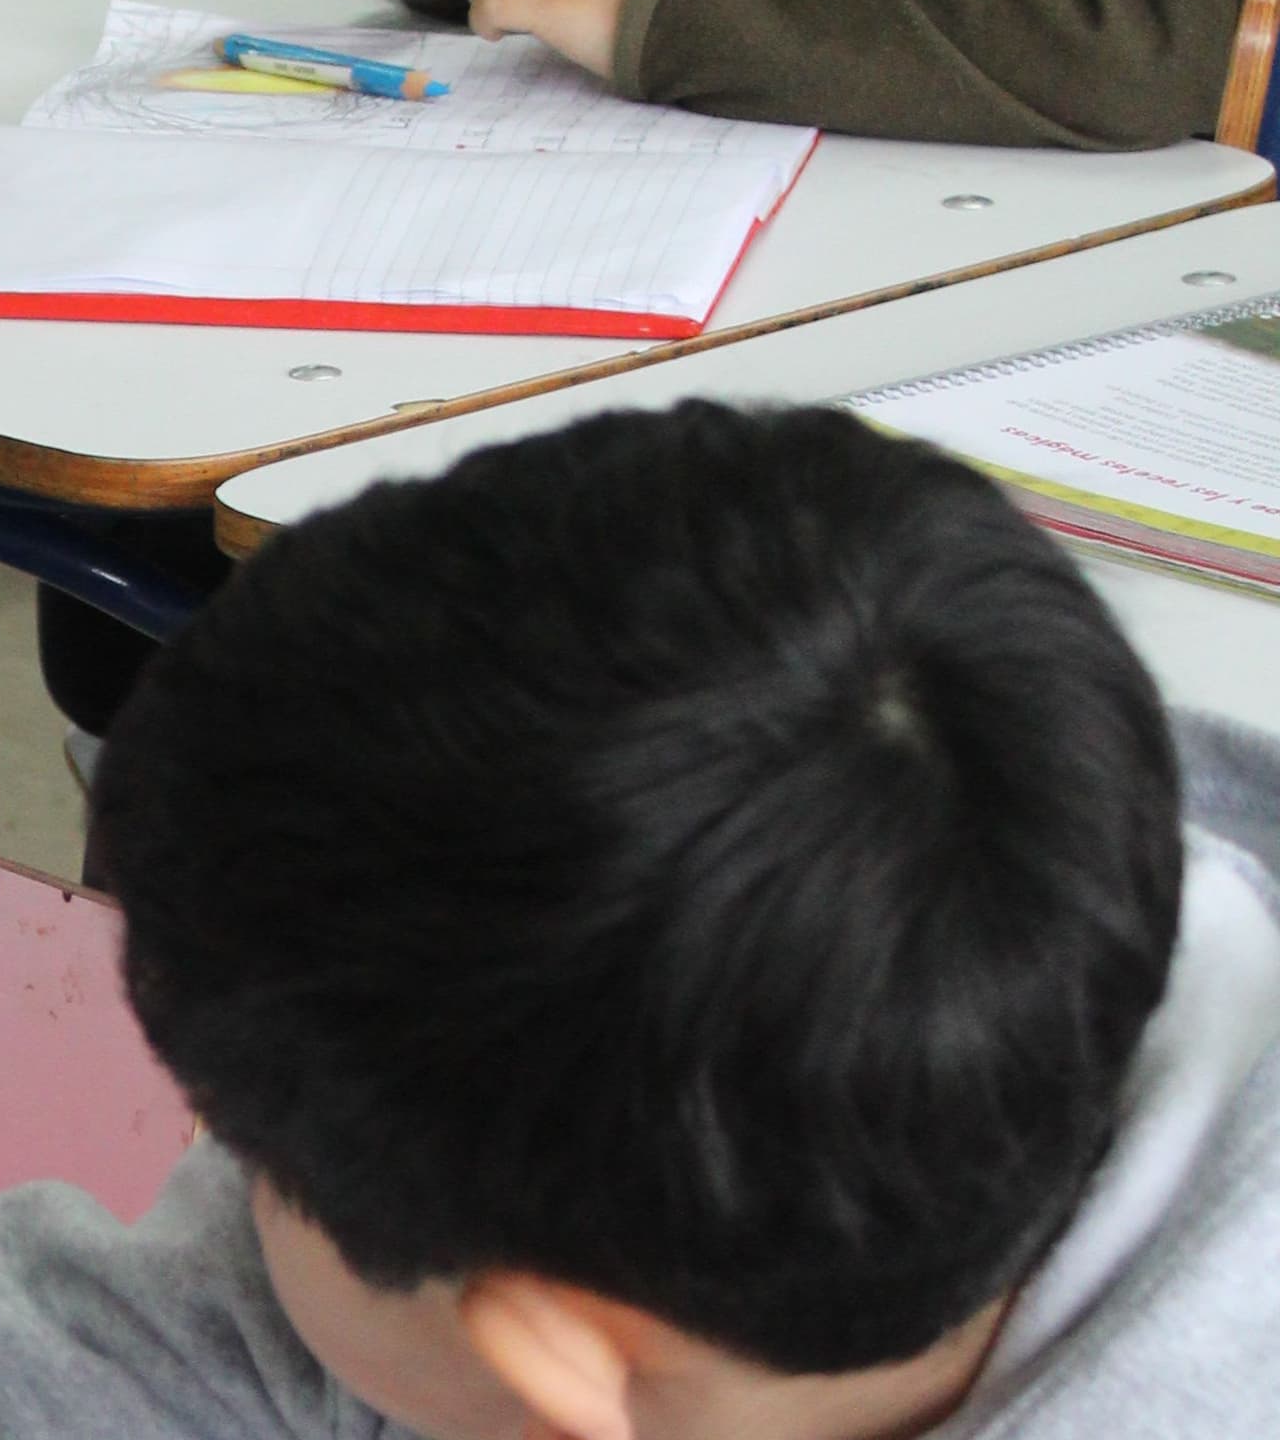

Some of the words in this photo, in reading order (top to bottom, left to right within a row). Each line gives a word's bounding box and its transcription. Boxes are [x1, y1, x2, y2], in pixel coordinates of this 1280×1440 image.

[1000, 425, 1101, 461] mágicas
[1099, 458, 1190, 490] recetas
[1190, 485, 1230, 503] las
